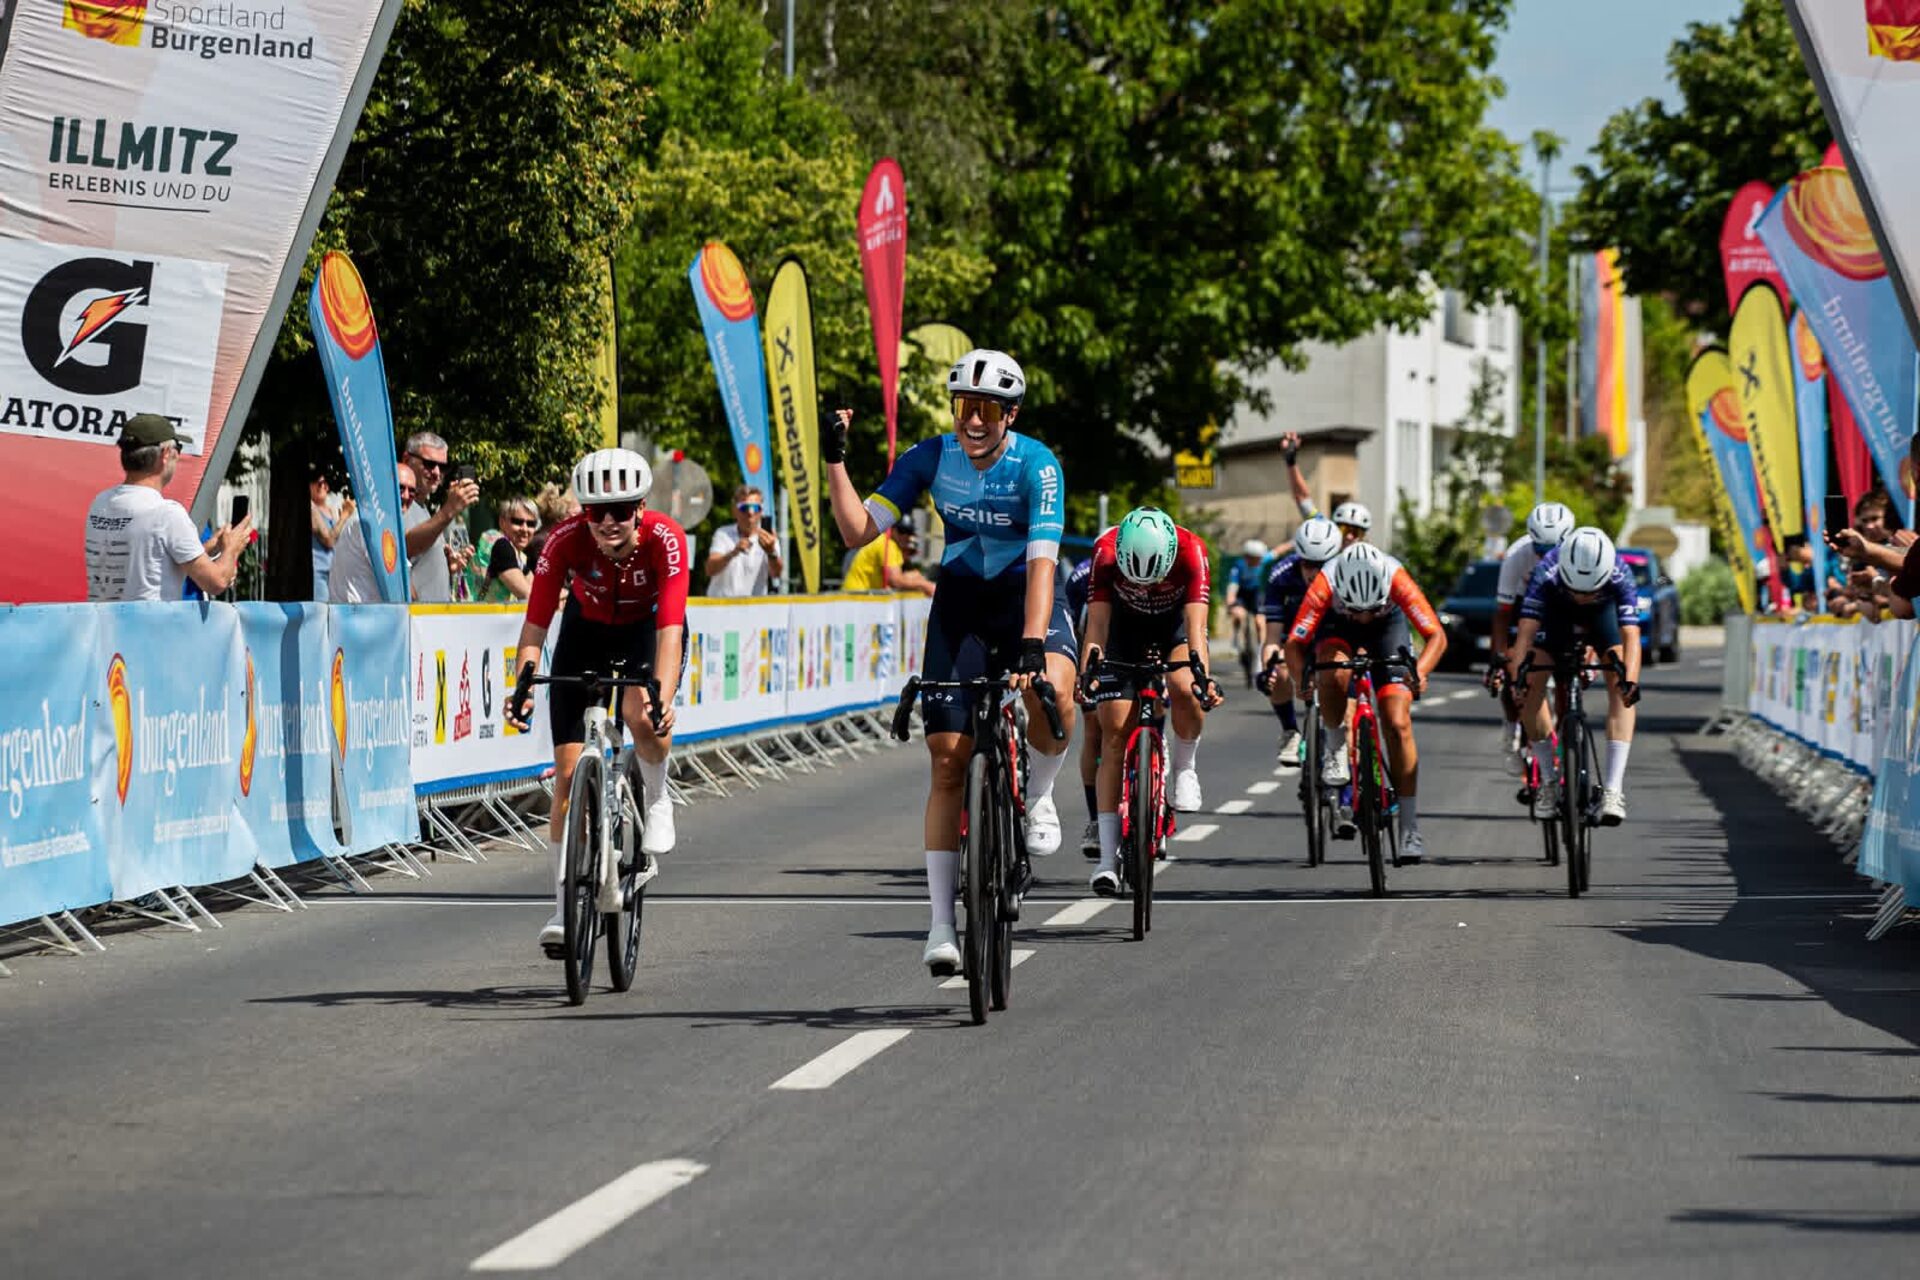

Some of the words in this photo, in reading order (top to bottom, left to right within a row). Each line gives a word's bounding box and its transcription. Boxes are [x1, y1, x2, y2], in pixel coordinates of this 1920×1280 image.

[154, 0, 285, 30] Sportland
[151, 26, 314, 60] Burgenland
[49, 116, 239, 177] ILLMITZ
[49, 172, 147, 196] ERLEBNIS
[153, 182, 196, 200] UND
[202, 185, 231, 201] DU
[0, 397, 183, 437] ATORA
[1039, 465, 1058, 516] FRIIS
[943, 501, 1013, 527] FRIIS
[138, 683, 233, 798] burgenland
[349, 673, 410, 772] burgenland
[0, 691, 87, 819] rgenland
